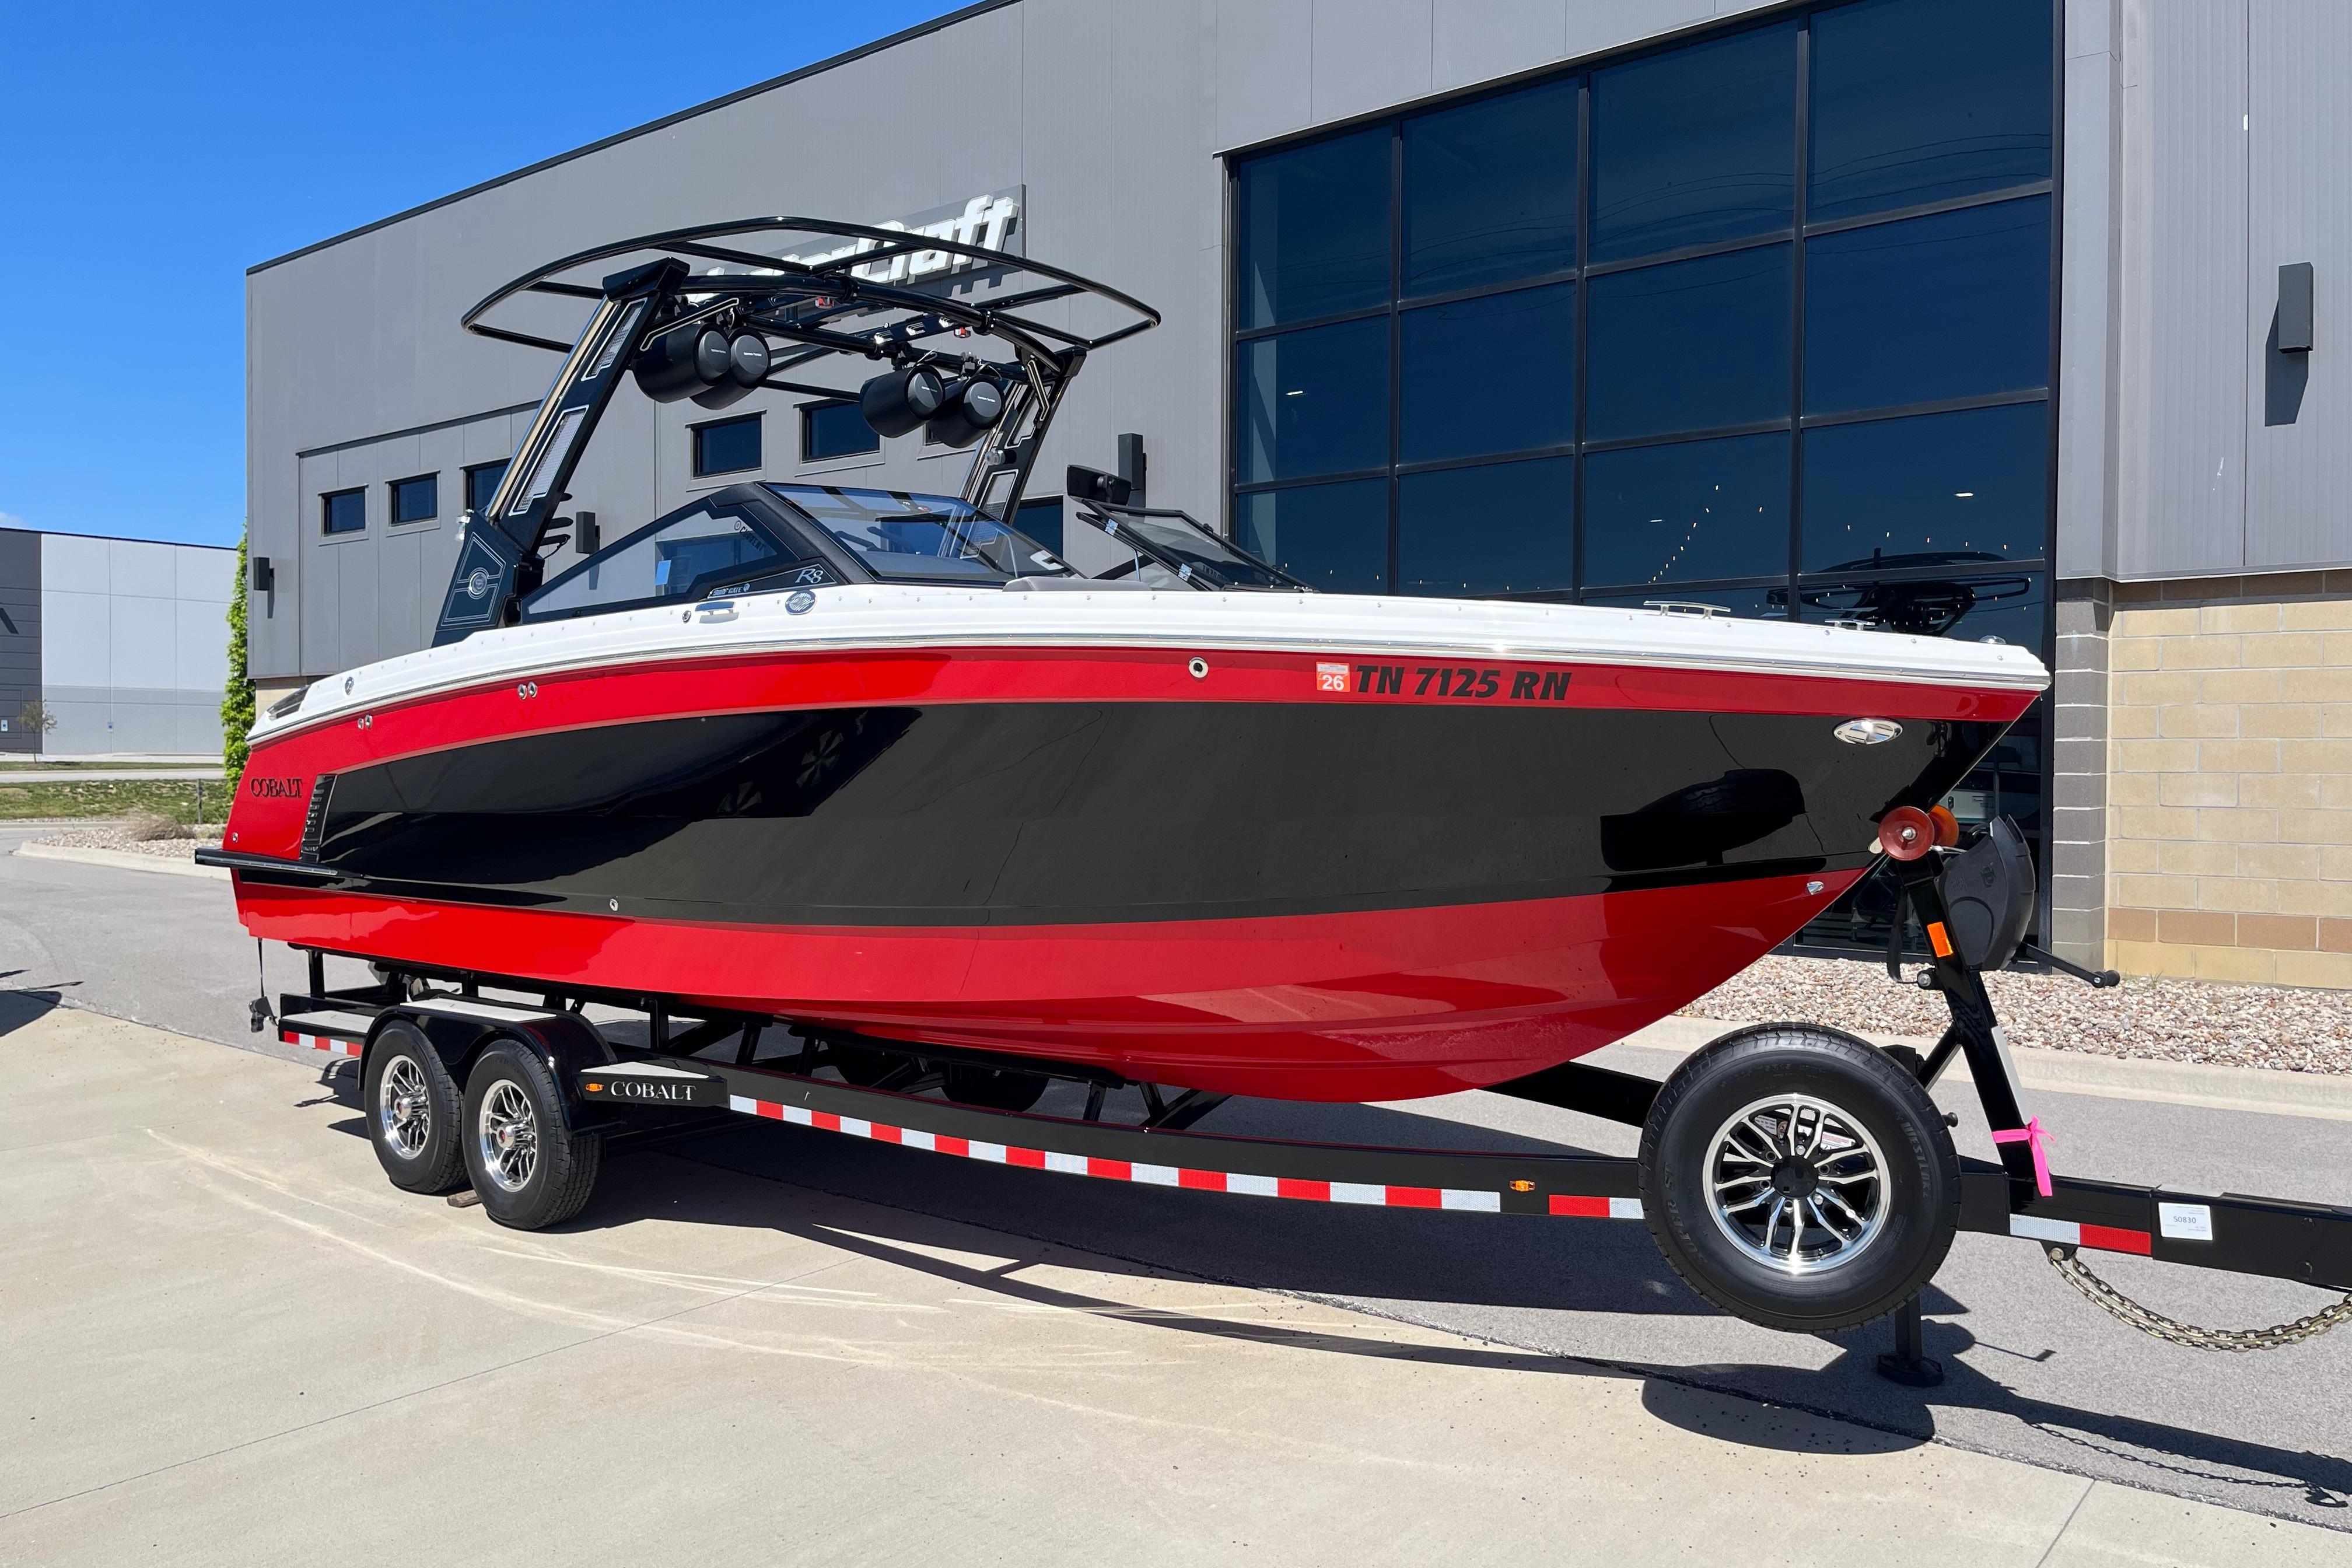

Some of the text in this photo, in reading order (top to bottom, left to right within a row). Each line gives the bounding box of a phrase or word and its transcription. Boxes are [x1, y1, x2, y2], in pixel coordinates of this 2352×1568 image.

[794, 568, 824, 584] R8
[1322, 674, 1345, 691] 26
[1357, 664, 1572, 701] TN 7125 RN
[250, 778, 303, 798] COBALT
[610, 1081, 696, 1101] COBALT
